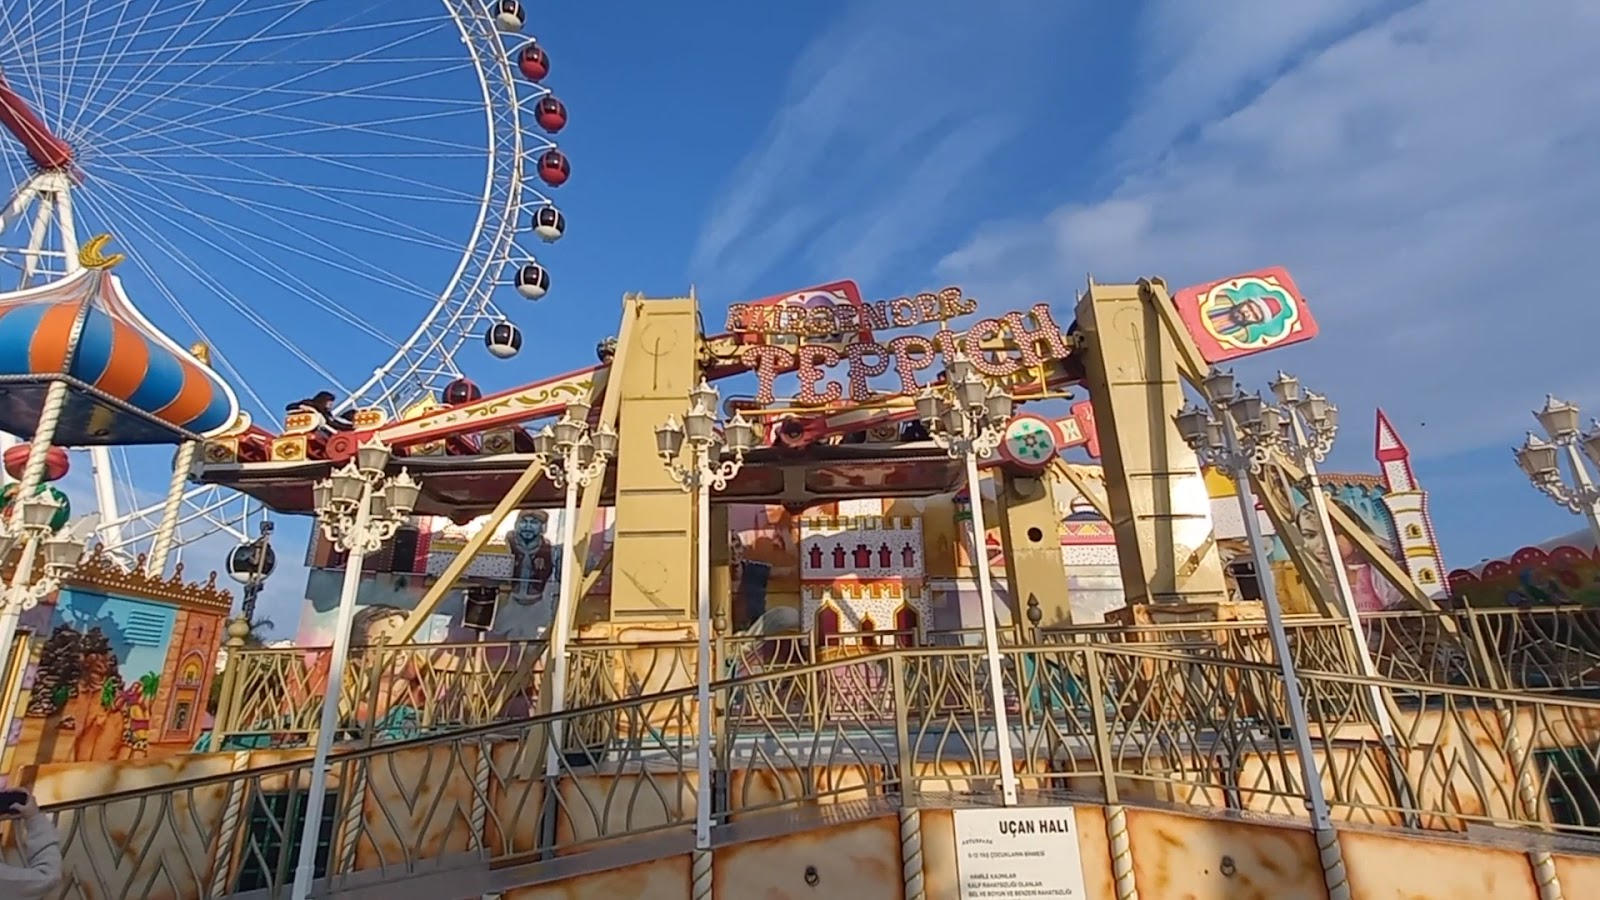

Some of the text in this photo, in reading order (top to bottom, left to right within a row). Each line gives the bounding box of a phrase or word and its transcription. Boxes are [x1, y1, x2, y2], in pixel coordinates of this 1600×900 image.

[725, 287, 978, 335] FLIEGENDER
[740, 303, 1072, 405] TEPPICH
[999, 819, 1069, 838] UÇAN HALI
